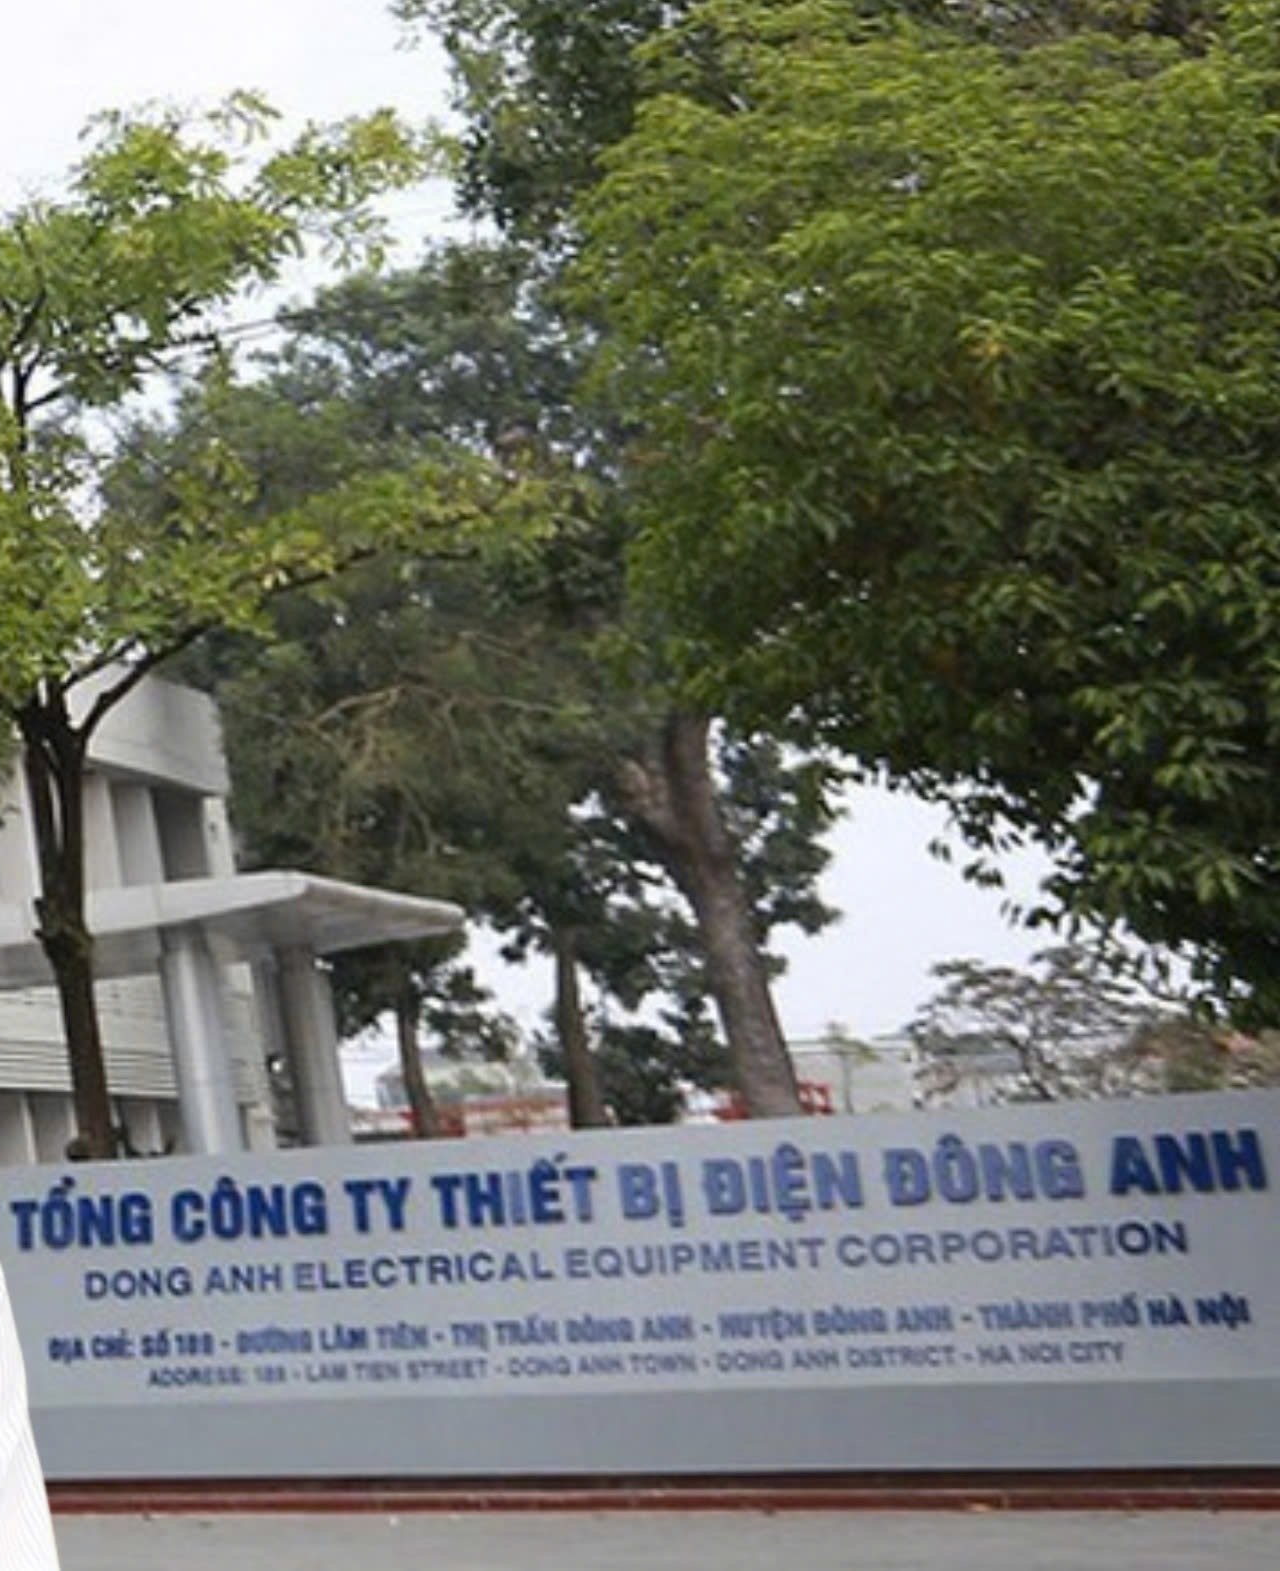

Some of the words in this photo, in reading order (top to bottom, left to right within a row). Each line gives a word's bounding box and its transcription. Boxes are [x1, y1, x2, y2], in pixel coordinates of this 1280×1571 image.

[11, 1175, 154, 1251] TỔNG
[171, 1175, 328, 1243] CÔNG
[343, 1177, 412, 1234] TY
[431, 1152, 598, 1230] THIẾT
[617, 1162, 686, 1229] BỊ
[702, 1142, 866, 1224] ĐIỆN
[882, 1133, 1085, 1208] ĐÔNG
[1110, 1129, 1267, 1195] ANH
[85, 1266, 192, 1300] DONG
[205, 1262, 283, 1295] ANH
[296, 1250, 554, 1292] ELECTRICAL
[564, 1237, 826, 1279] EQUIPMENT
[836, 1220, 1189, 1268] CORPORATION
[641, 1315, 694, 1340] ANH
[896, 1305, 955, 1332] ANH
[1146, 1292, 1190, 1326] HÀ
[1194, 1291, 1252, 1330] NỘI
[306, 1361, 348, 1382] LAM
[406, 1357, 488, 1379] STREET
[508, 1355, 572, 1377] DONG
[578, 1354, 624, 1375] ANH
[628, 1353, 697, 1375] TOWN
[716, 1350, 784, 1373] DONG
[792, 1348, 840, 1370] ANH
[845, 1345, 957, 1368] DISTRICT
[976, 1344, 1015, 1365] HA
[1069, 1340, 1125, 1364] CITY
